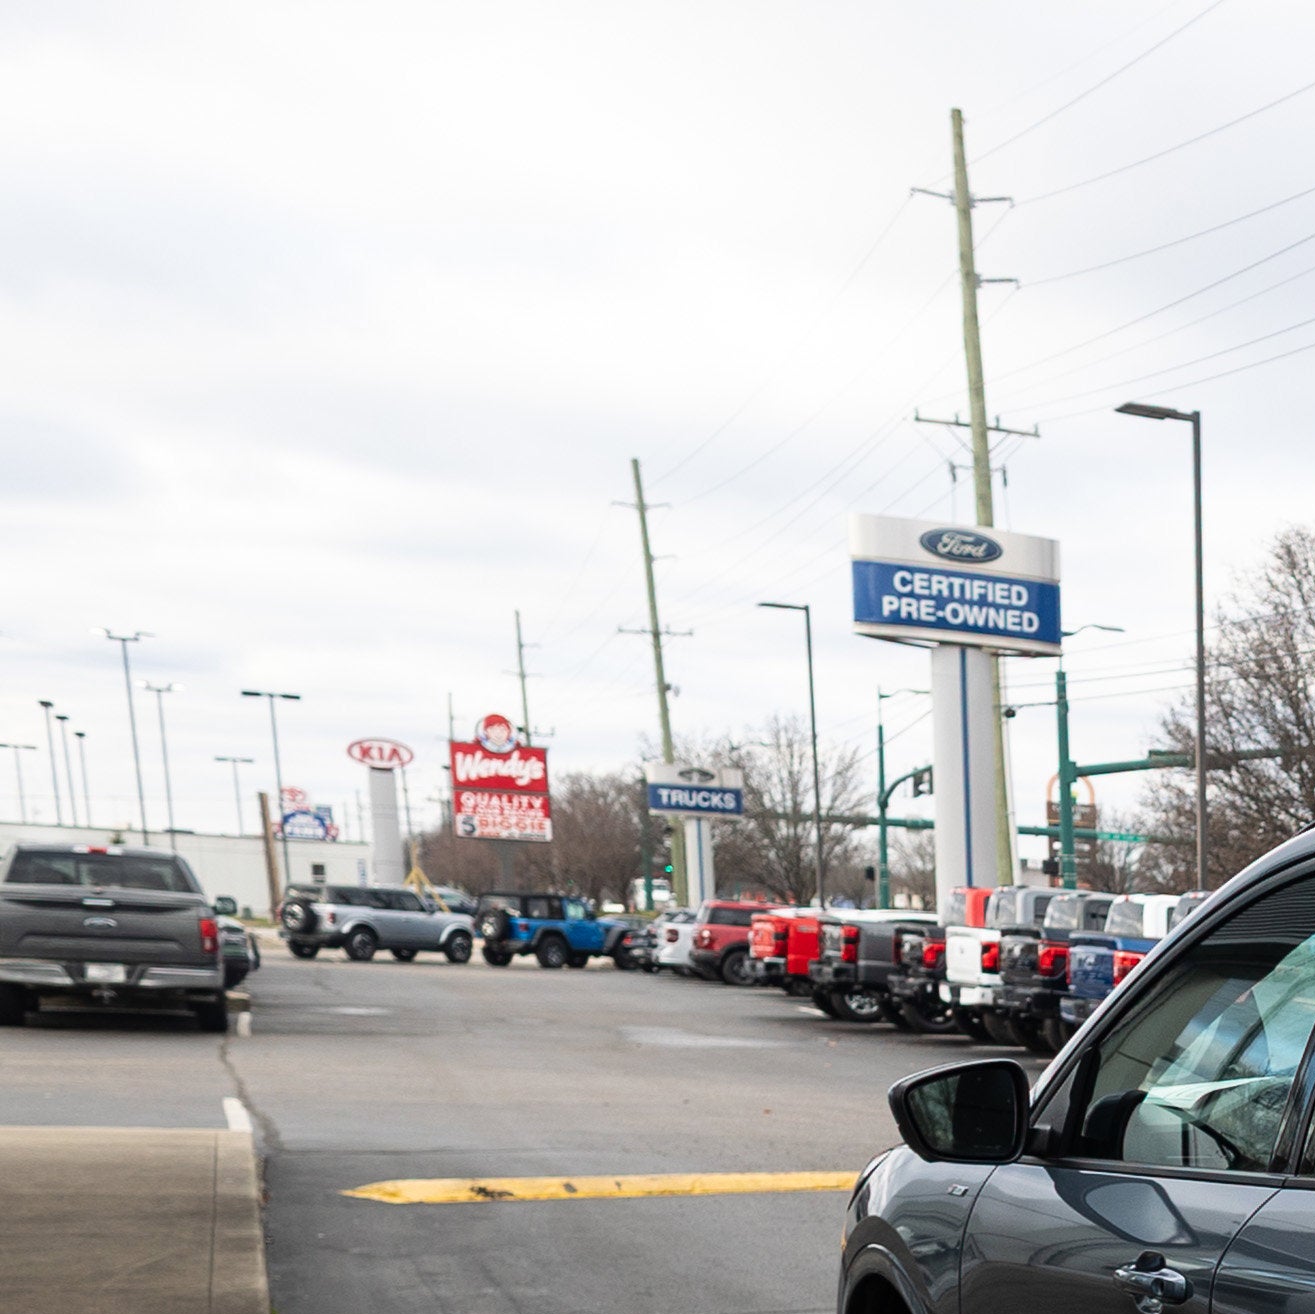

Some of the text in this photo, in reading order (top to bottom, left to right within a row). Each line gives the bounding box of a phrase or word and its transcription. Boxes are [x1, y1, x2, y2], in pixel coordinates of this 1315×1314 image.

[937, 531, 989, 557] Ford
[892, 570, 1029, 606] CERTIFIED
[881, 595, 1040, 633] PRE-OWNED
[359, 744, 403, 762] KIA
[455, 750, 546, 787] Wendy's
[657, 787, 737, 810] TRUCKS
